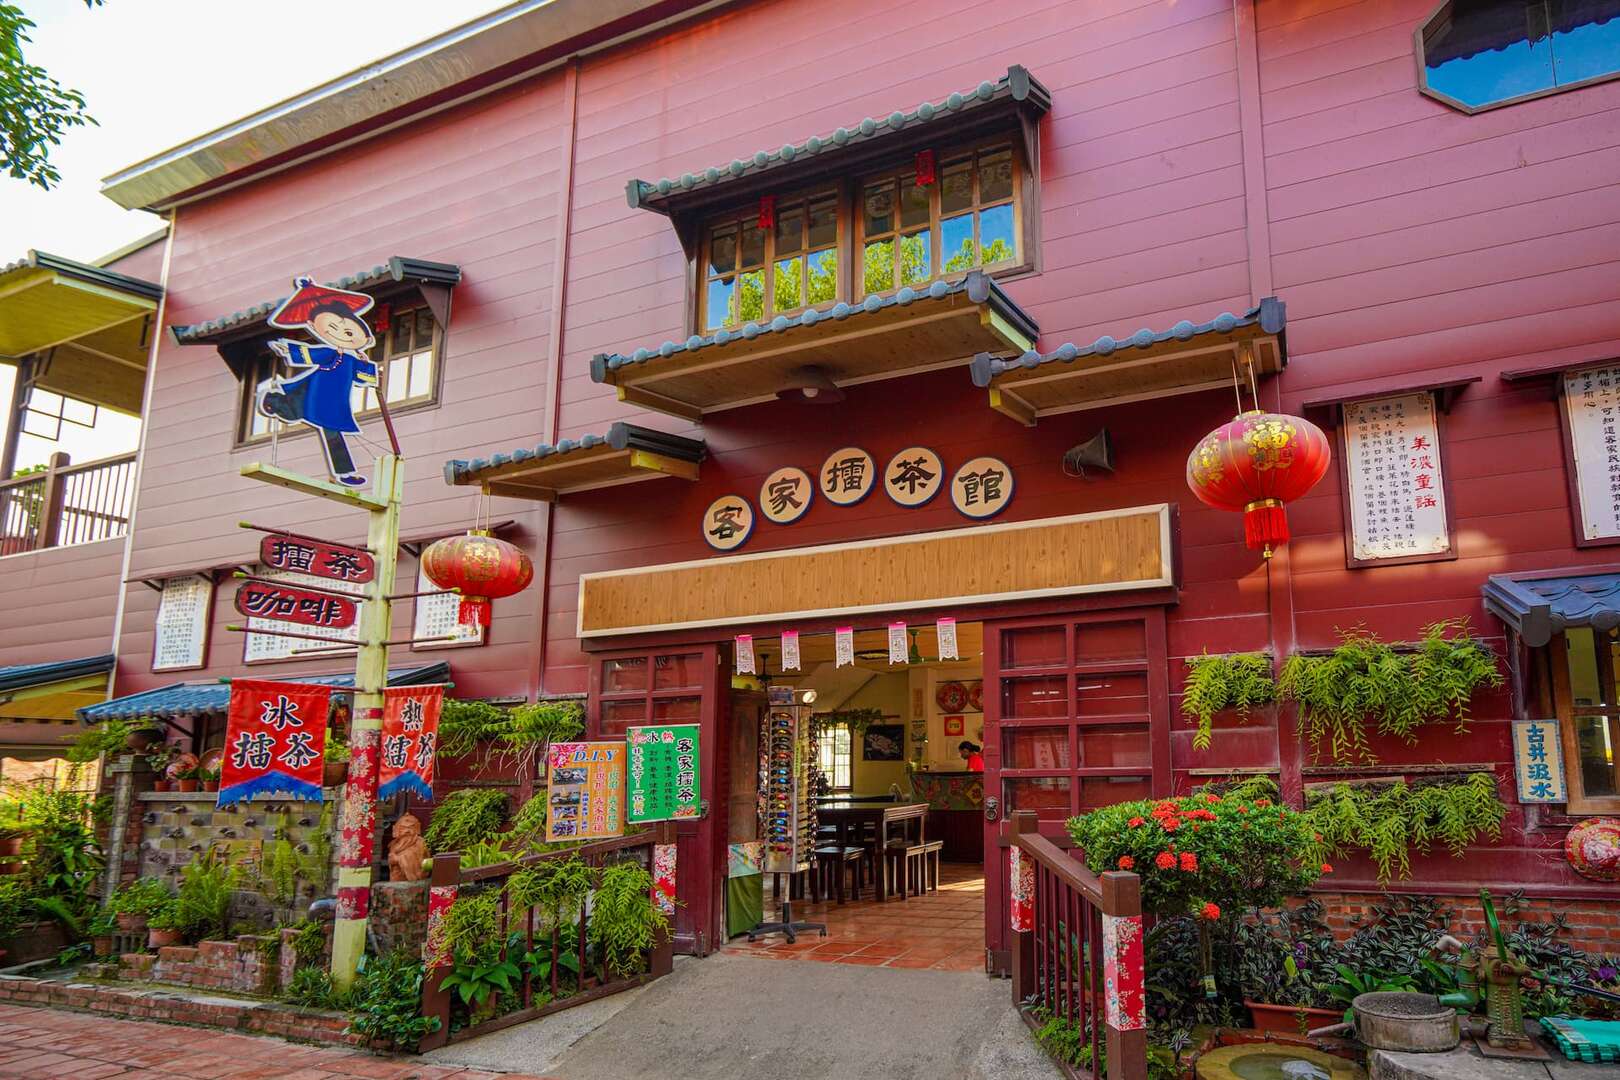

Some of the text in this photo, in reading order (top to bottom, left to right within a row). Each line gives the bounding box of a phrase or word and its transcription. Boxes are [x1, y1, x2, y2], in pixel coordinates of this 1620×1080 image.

[1410, 435, 1437, 510] 美濃童謠
[710, 456, 1004, 540] 客家擂茶館
[272, 541, 367, 579] 擂茶
[247, 591, 342, 624] 咖啡
[261, 695, 303, 731] 冰
[401, 697, 424, 732] 熱
[232, 732, 320, 770] 擂茶
[384, 732, 435, 769] 擂茶
[573, 750, 616, 762] D.I.Y
[1526, 723, 1556, 798] 古井汲水
[676, 738, 696, 803] 客家擂茶
